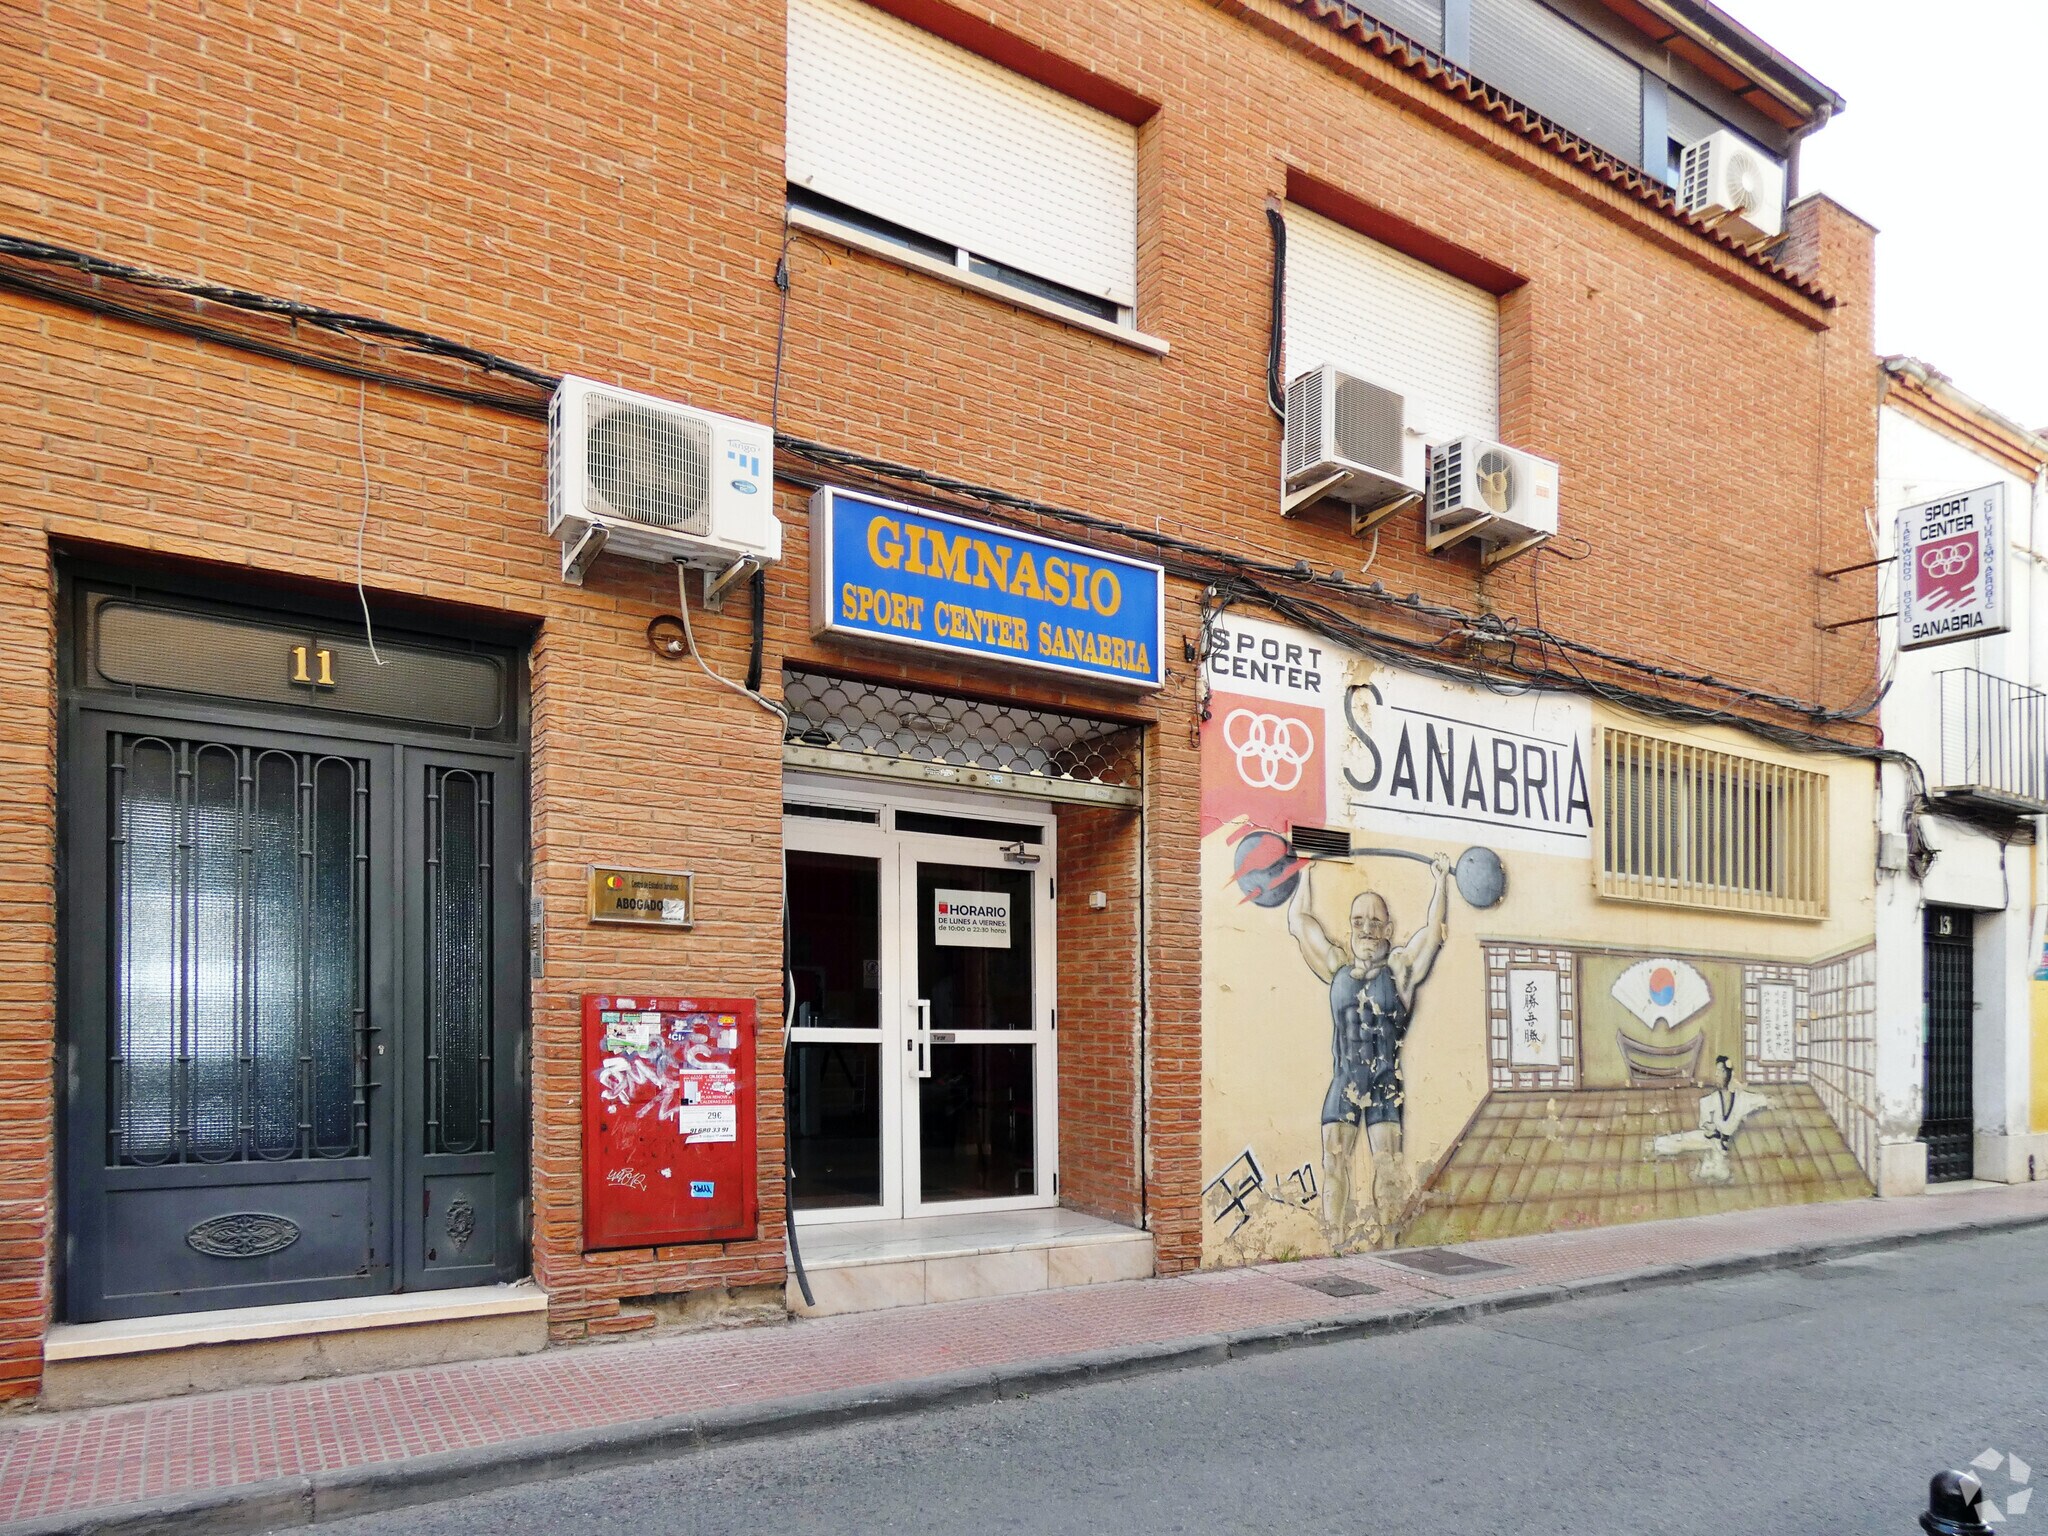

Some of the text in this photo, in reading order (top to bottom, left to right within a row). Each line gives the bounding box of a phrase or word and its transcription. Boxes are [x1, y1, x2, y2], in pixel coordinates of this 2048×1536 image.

[1925, 497, 1969, 522] SPORT
[1920, 514, 1974, 541] CENTER
[867, 516, 1122, 616] GIMNASIO
[1902, 521, 1912, 624] TAEKWONDO BOXEO
[842, 582, 1151, 674] SPORT CENTER SANABRIA
[1912, 611, 1984, 639] SANABRIA
[1211, 627, 1322, 669] SPORT
[292, 646, 335, 685] 11
[1211, 653, 1322, 693] CENTER
[1342, 684, 1594, 828] SANABRIA
[949, 904, 1007, 918] HORARIO
[979, 919, 1007, 927] VIERNES:
[1939, 914, 1952, 935] 13
[990, 926, 1007, 934] horas
[707, 1111, 722, 1119] 29€
